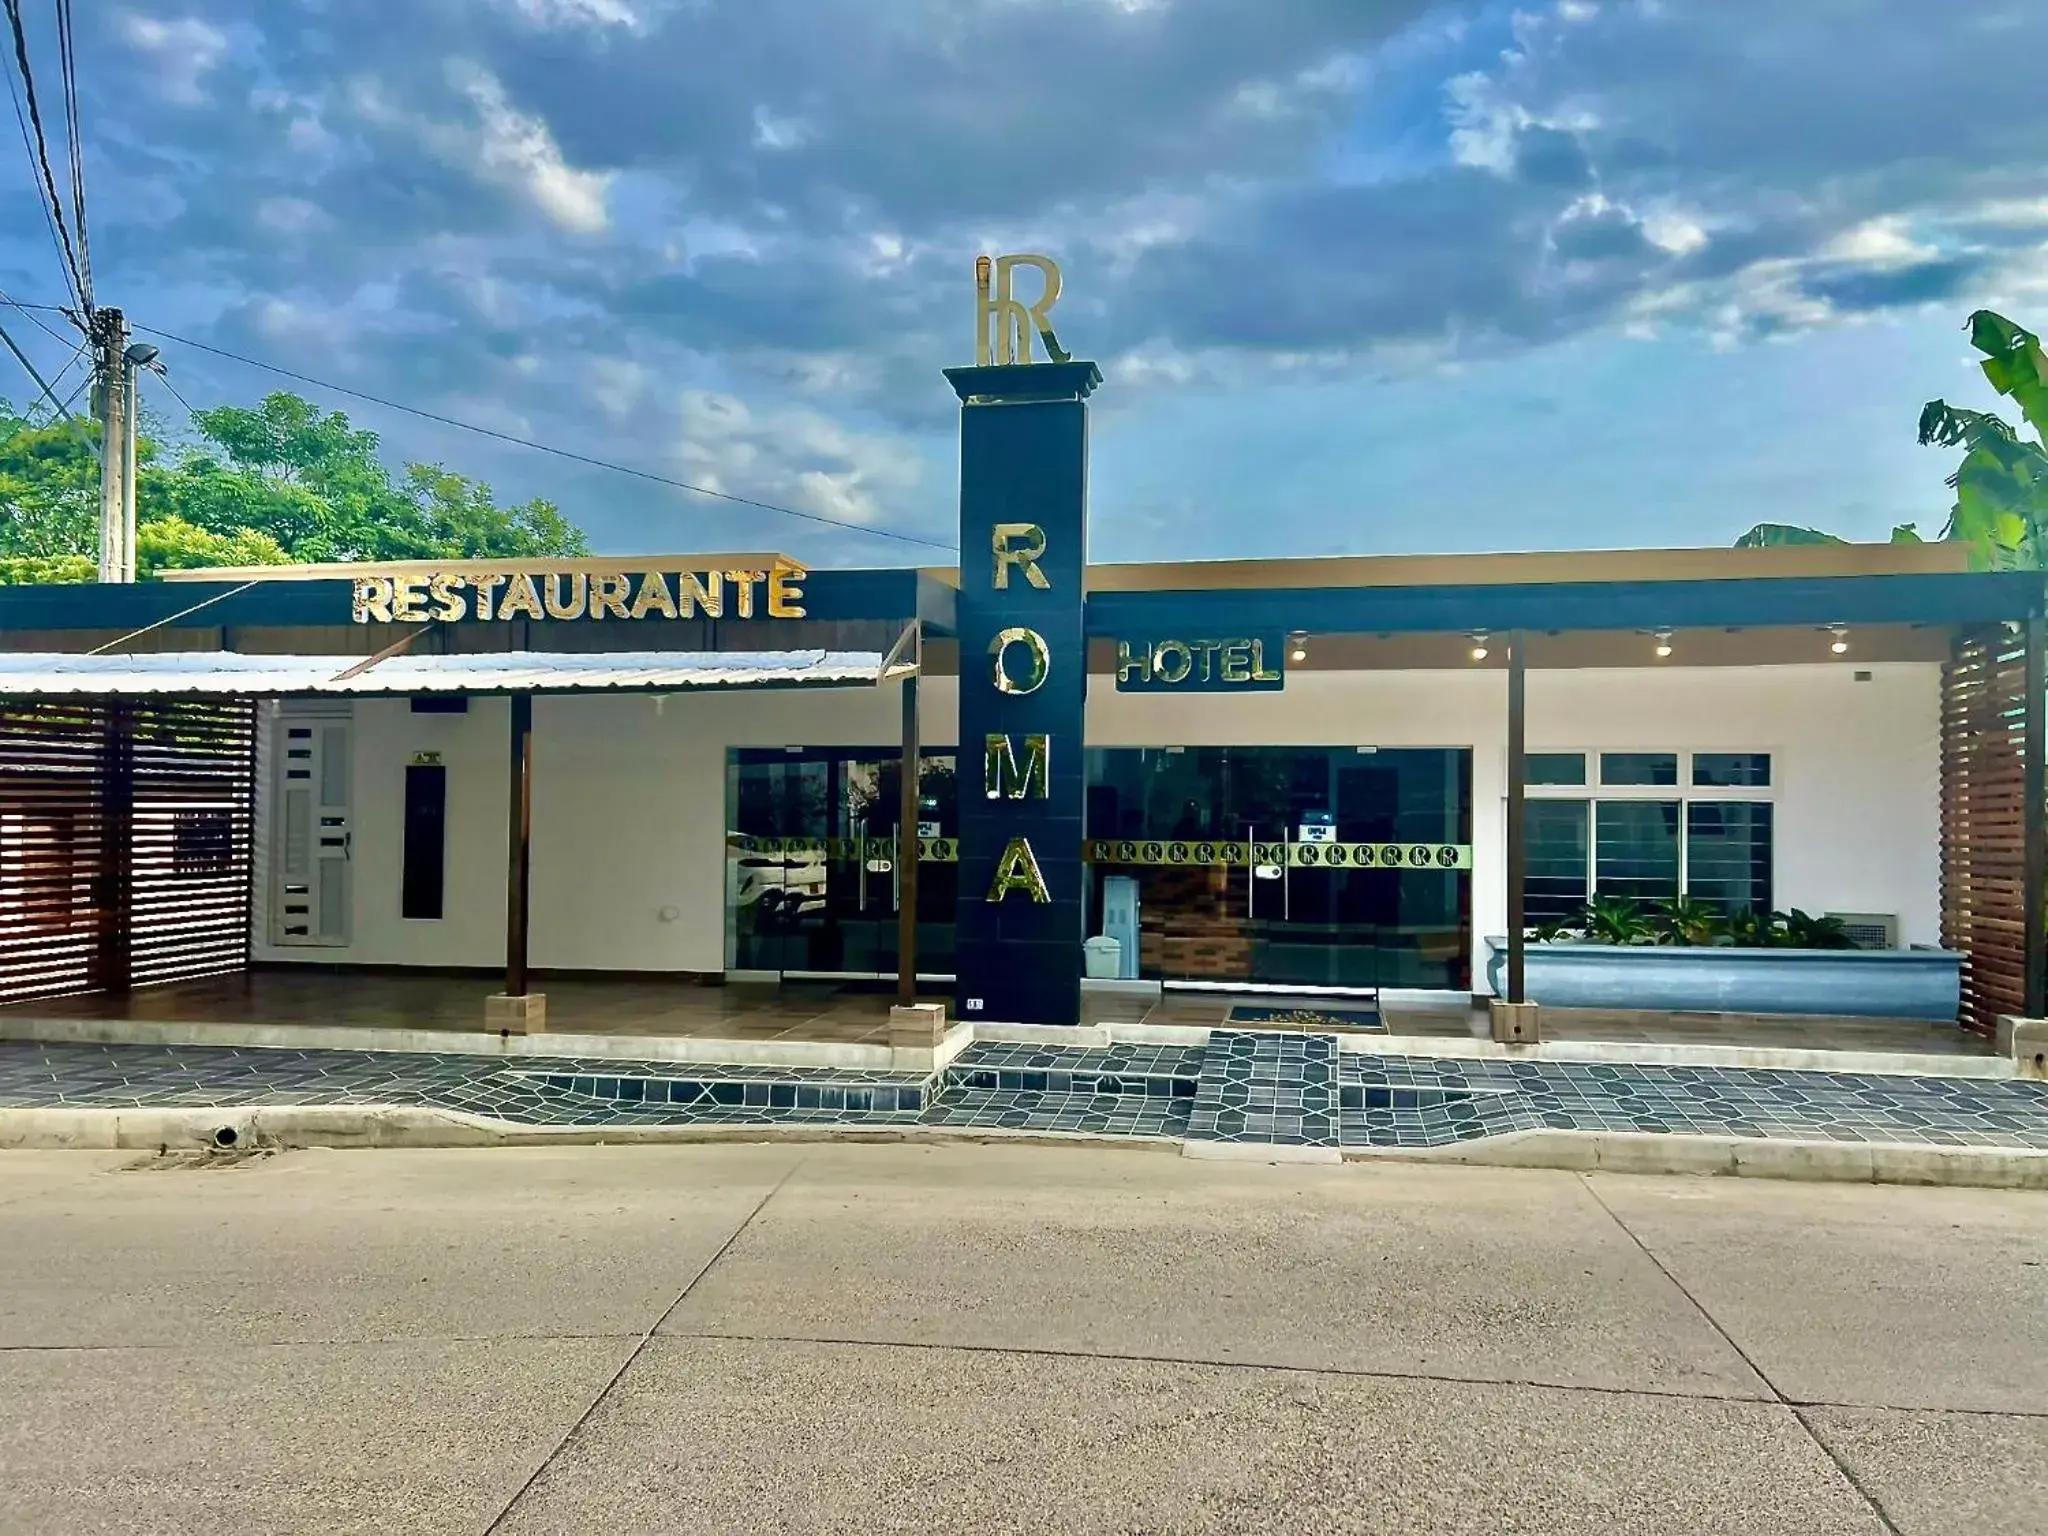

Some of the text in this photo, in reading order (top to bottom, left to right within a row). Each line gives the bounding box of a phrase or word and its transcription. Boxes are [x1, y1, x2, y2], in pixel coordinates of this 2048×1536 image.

[352, 570, 807, 623] RESTAURANTE
[1118, 638, 1281, 682] HOTEL
[987, 523, 1051, 902] ROMA
